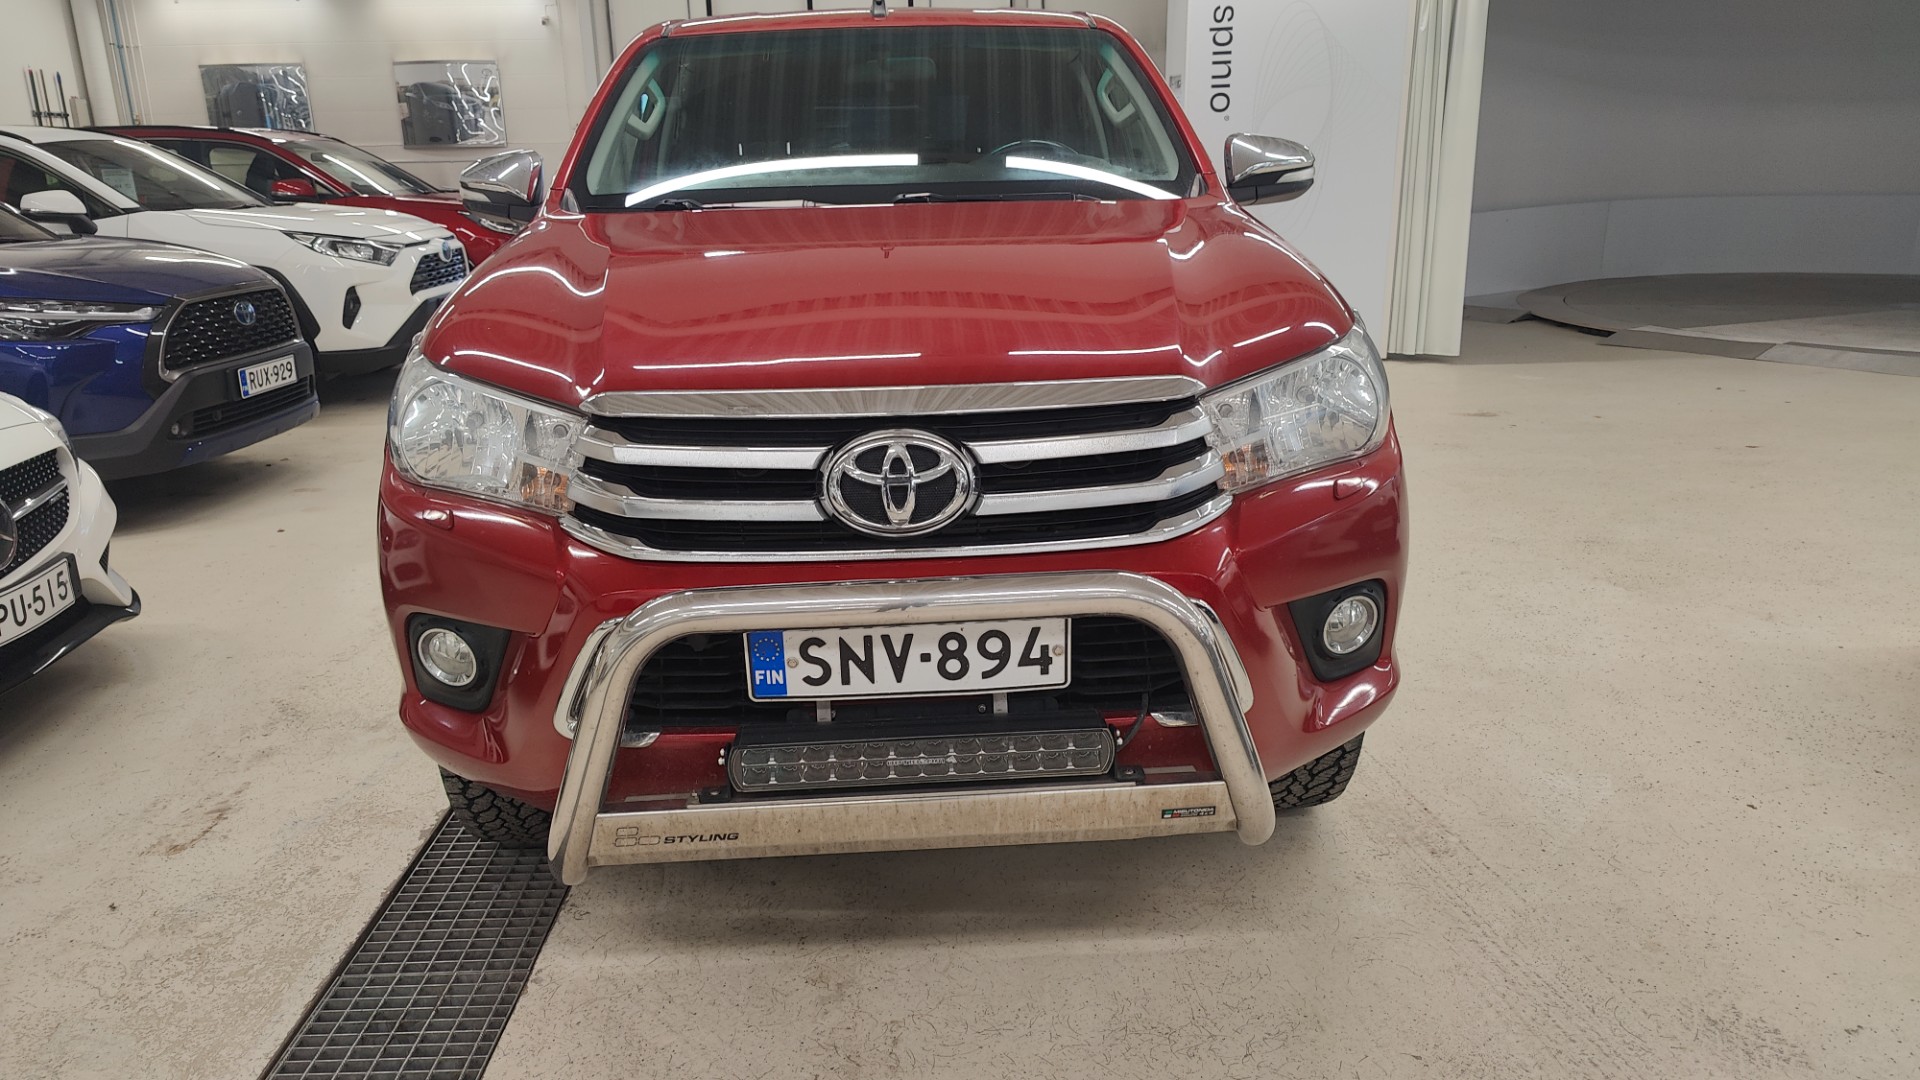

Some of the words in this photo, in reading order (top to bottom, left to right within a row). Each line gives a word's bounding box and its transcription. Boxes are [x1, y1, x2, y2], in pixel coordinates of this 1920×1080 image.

[248, 361, 293, 391] RUX-929
[799, 626, 1053, 687] SNV-894
[755, 669, 784, 685] FIN
[663, 832, 740, 845] STYLING
